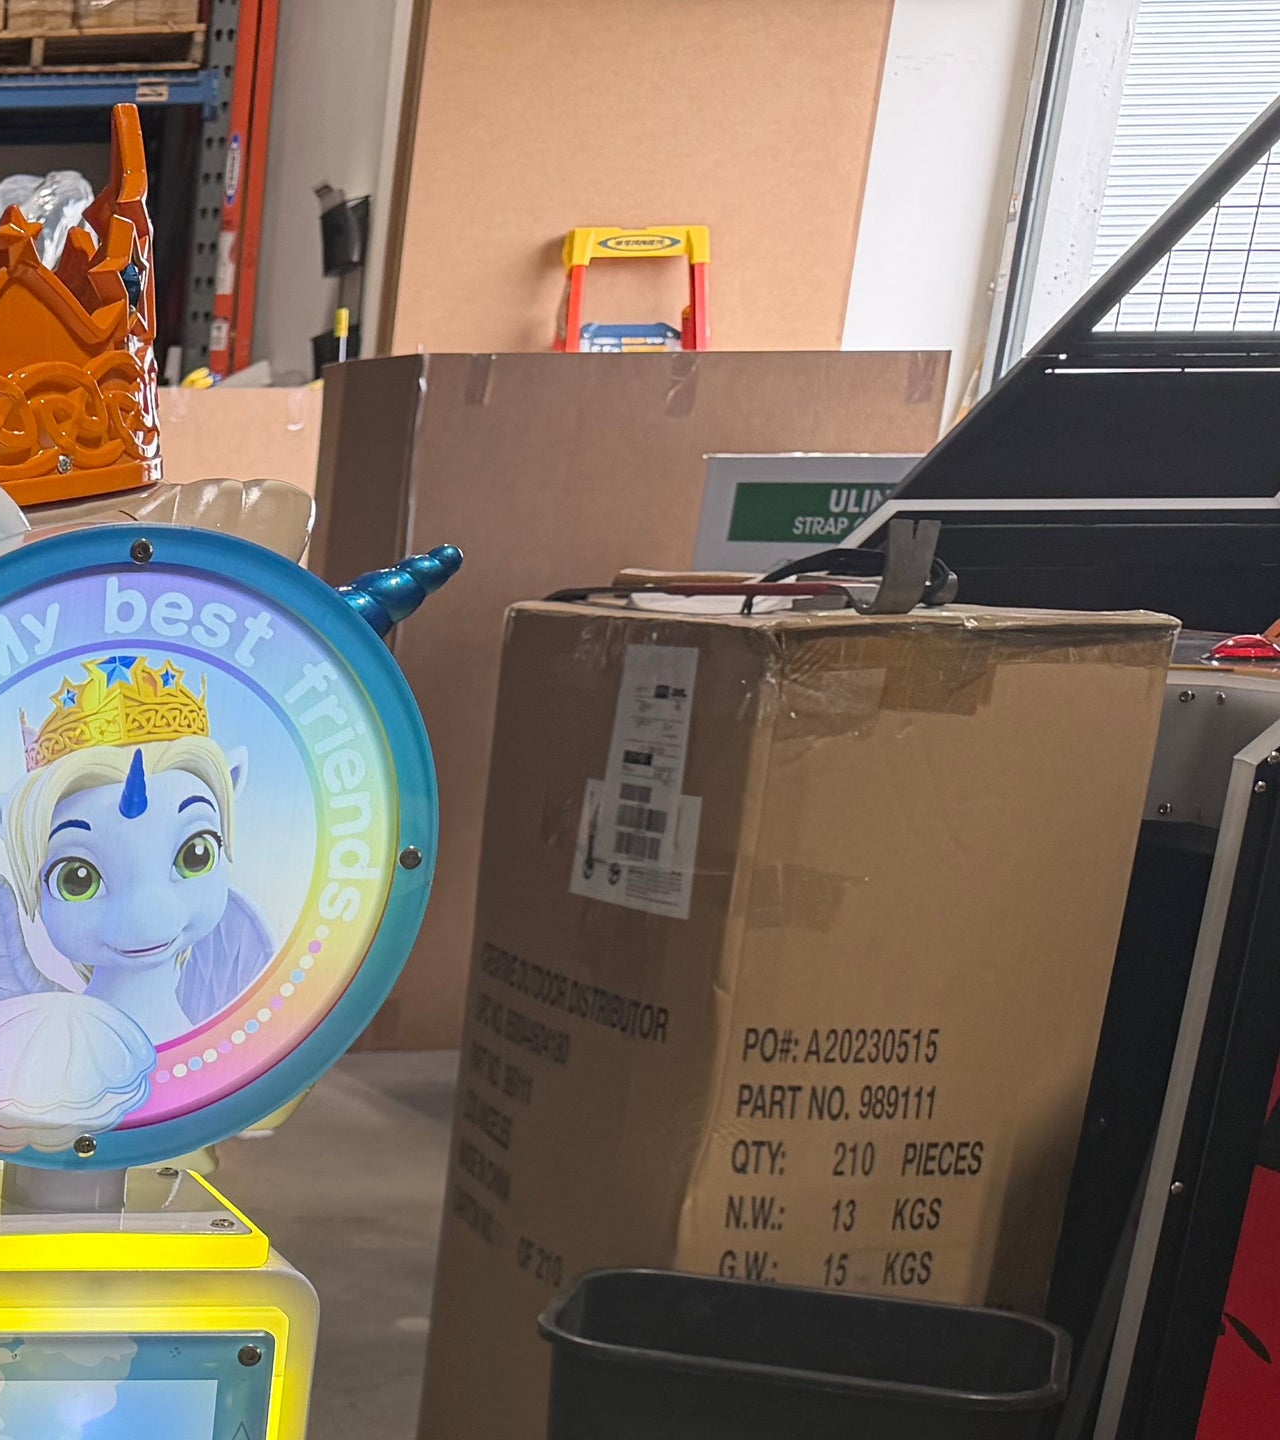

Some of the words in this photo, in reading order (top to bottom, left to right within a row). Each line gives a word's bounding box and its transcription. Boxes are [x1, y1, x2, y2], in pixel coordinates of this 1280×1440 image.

[792, 516, 849, 535] STRAP
[104, 577, 276, 668] best
[283, 661, 380, 923] friends
[742, 1028, 799, 1064] PO#:
[804, 1027, 939, 1066] A20230515
[736, 1085, 802, 1120] PART
[807, 1085, 850, 1121] NO.
[858, 1084, 936, 1121] 989111
[731, 1139, 786, 1177] QTY:
[832, 1141, 874, 1178] 210
[901, 1140, 984, 1178] PIECES
[724, 1196, 785, 1232] N.W.:
[831, 1198, 856, 1233] 13
[891, 1196, 942, 1232] KGS
[823, 1253, 847, 1287] 15
[882, 1251, 933, 1286] KGS
